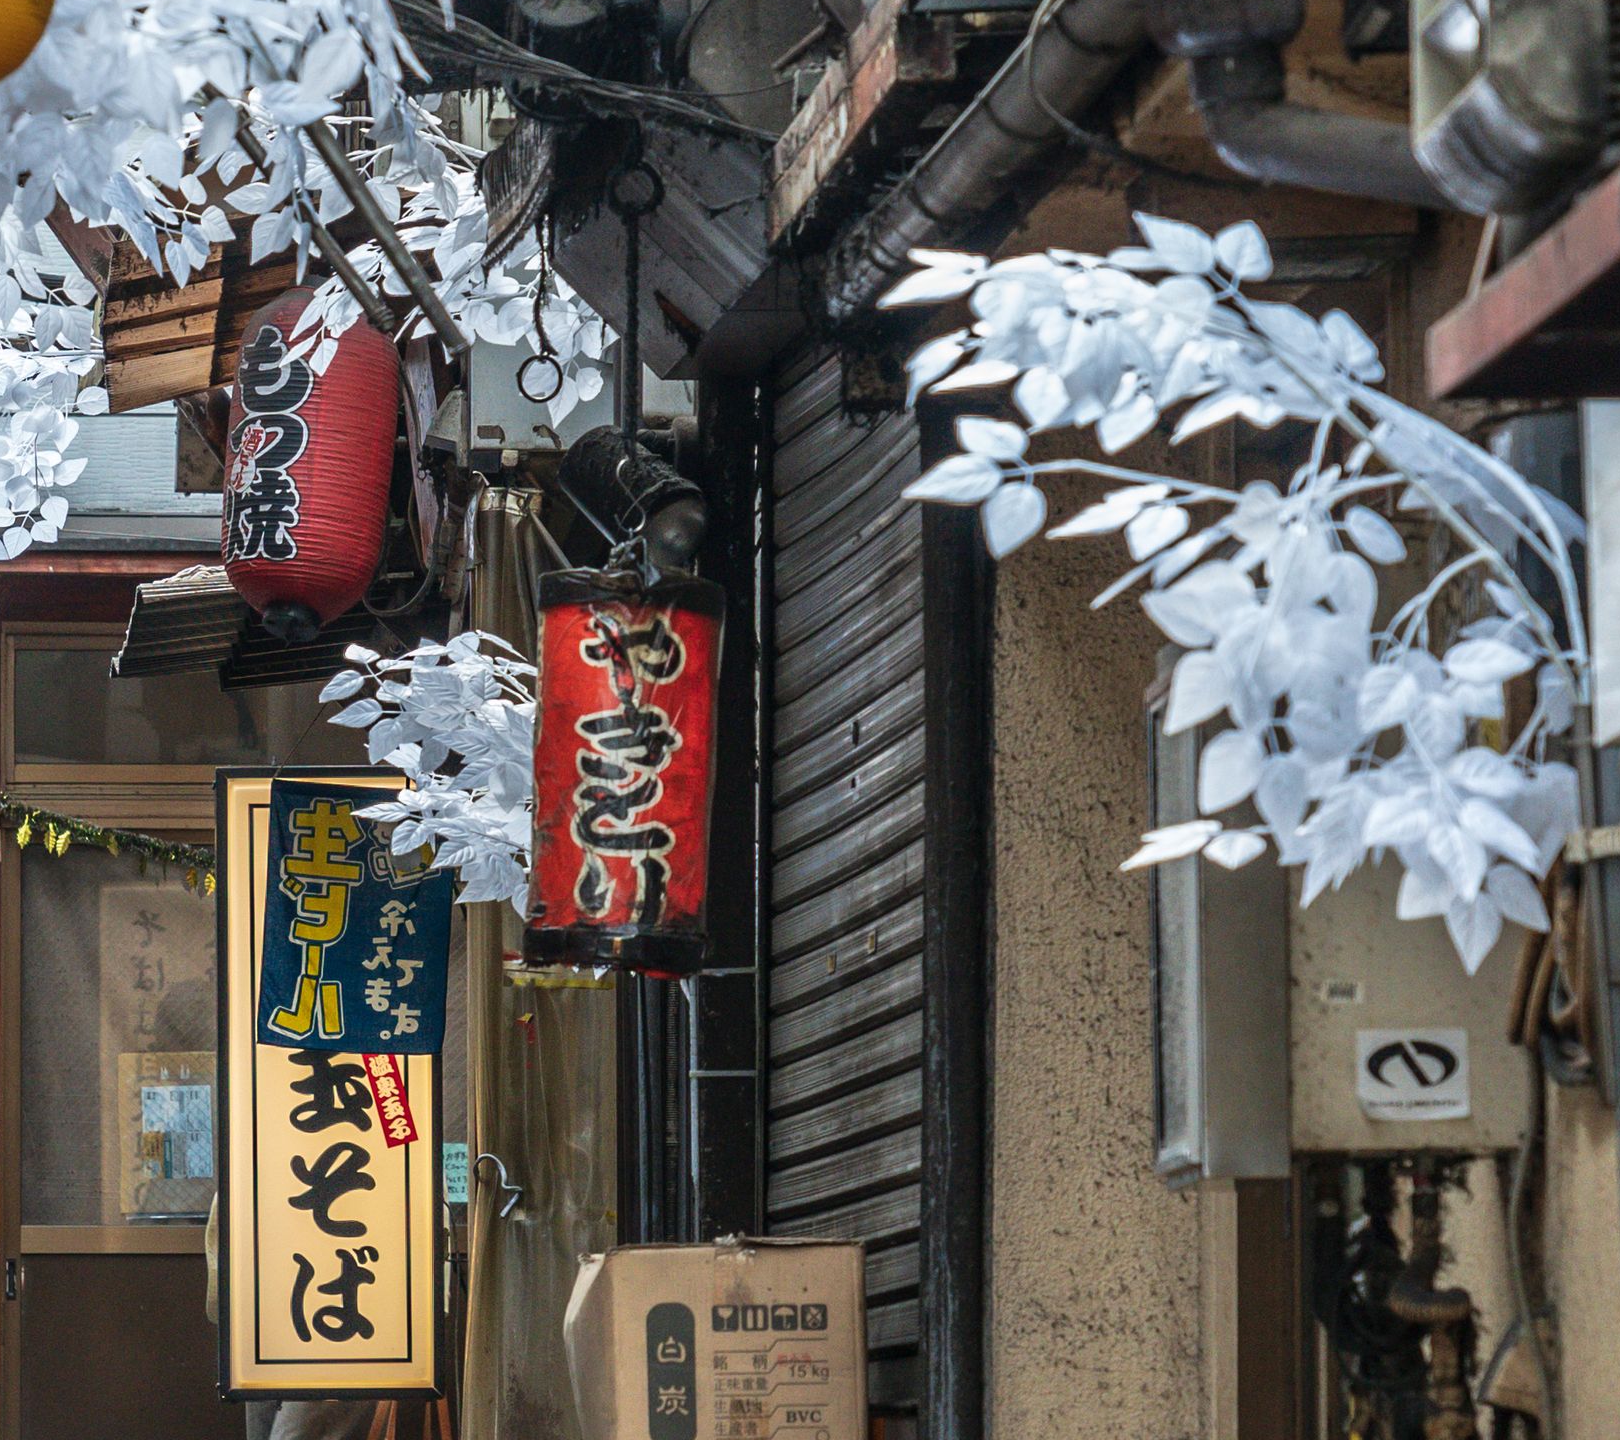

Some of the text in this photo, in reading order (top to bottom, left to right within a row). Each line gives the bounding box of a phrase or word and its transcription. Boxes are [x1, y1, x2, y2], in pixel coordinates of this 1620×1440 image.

[222, 323, 315, 564] もつ焼
[656, 1335, 690, 1417] 白炭
[789, 1364, 808, 1378] 15
[785, 1409, 823, 1423] BVC
